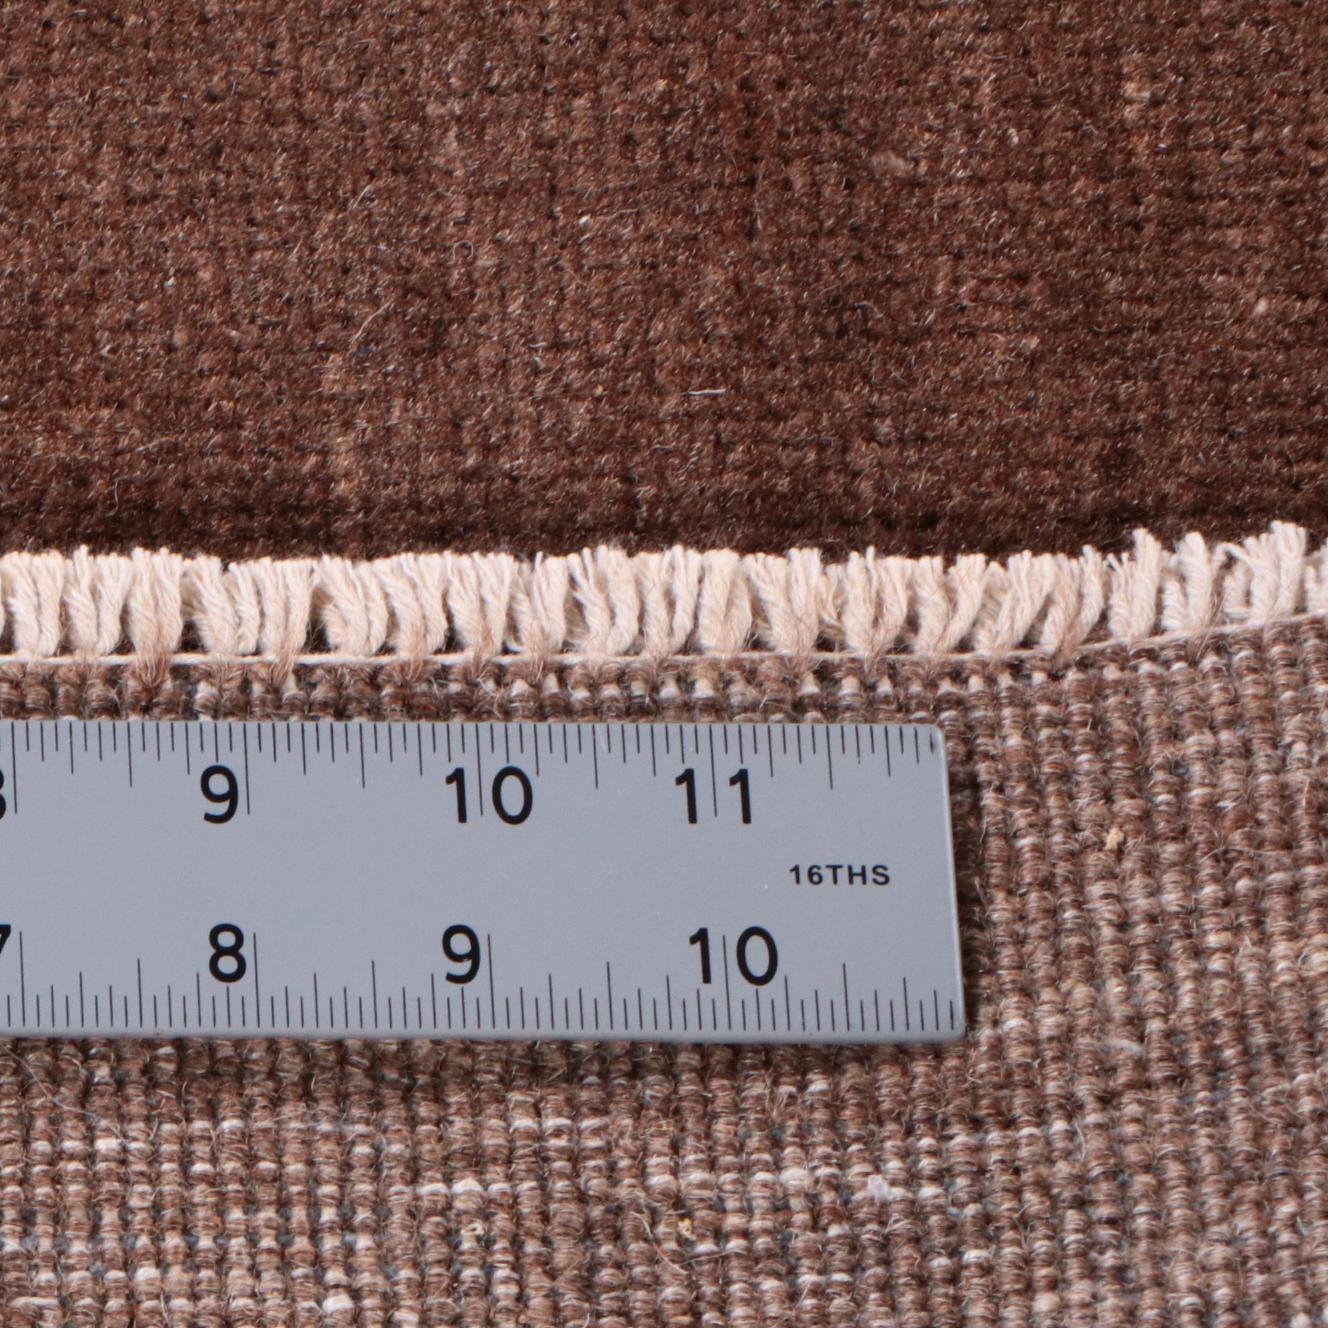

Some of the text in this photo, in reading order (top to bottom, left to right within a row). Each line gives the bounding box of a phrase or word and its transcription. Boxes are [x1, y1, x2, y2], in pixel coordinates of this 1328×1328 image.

[199, 763, 240, 826] 9
[444, 764, 535, 827] 10
[674, 767, 753, 826] 11
[788, 863, 891, 887] 16THS
[207, 922, 248, 985] 8
[440, 923, 482, 986] 9
[688, 925, 780, 988] 10
